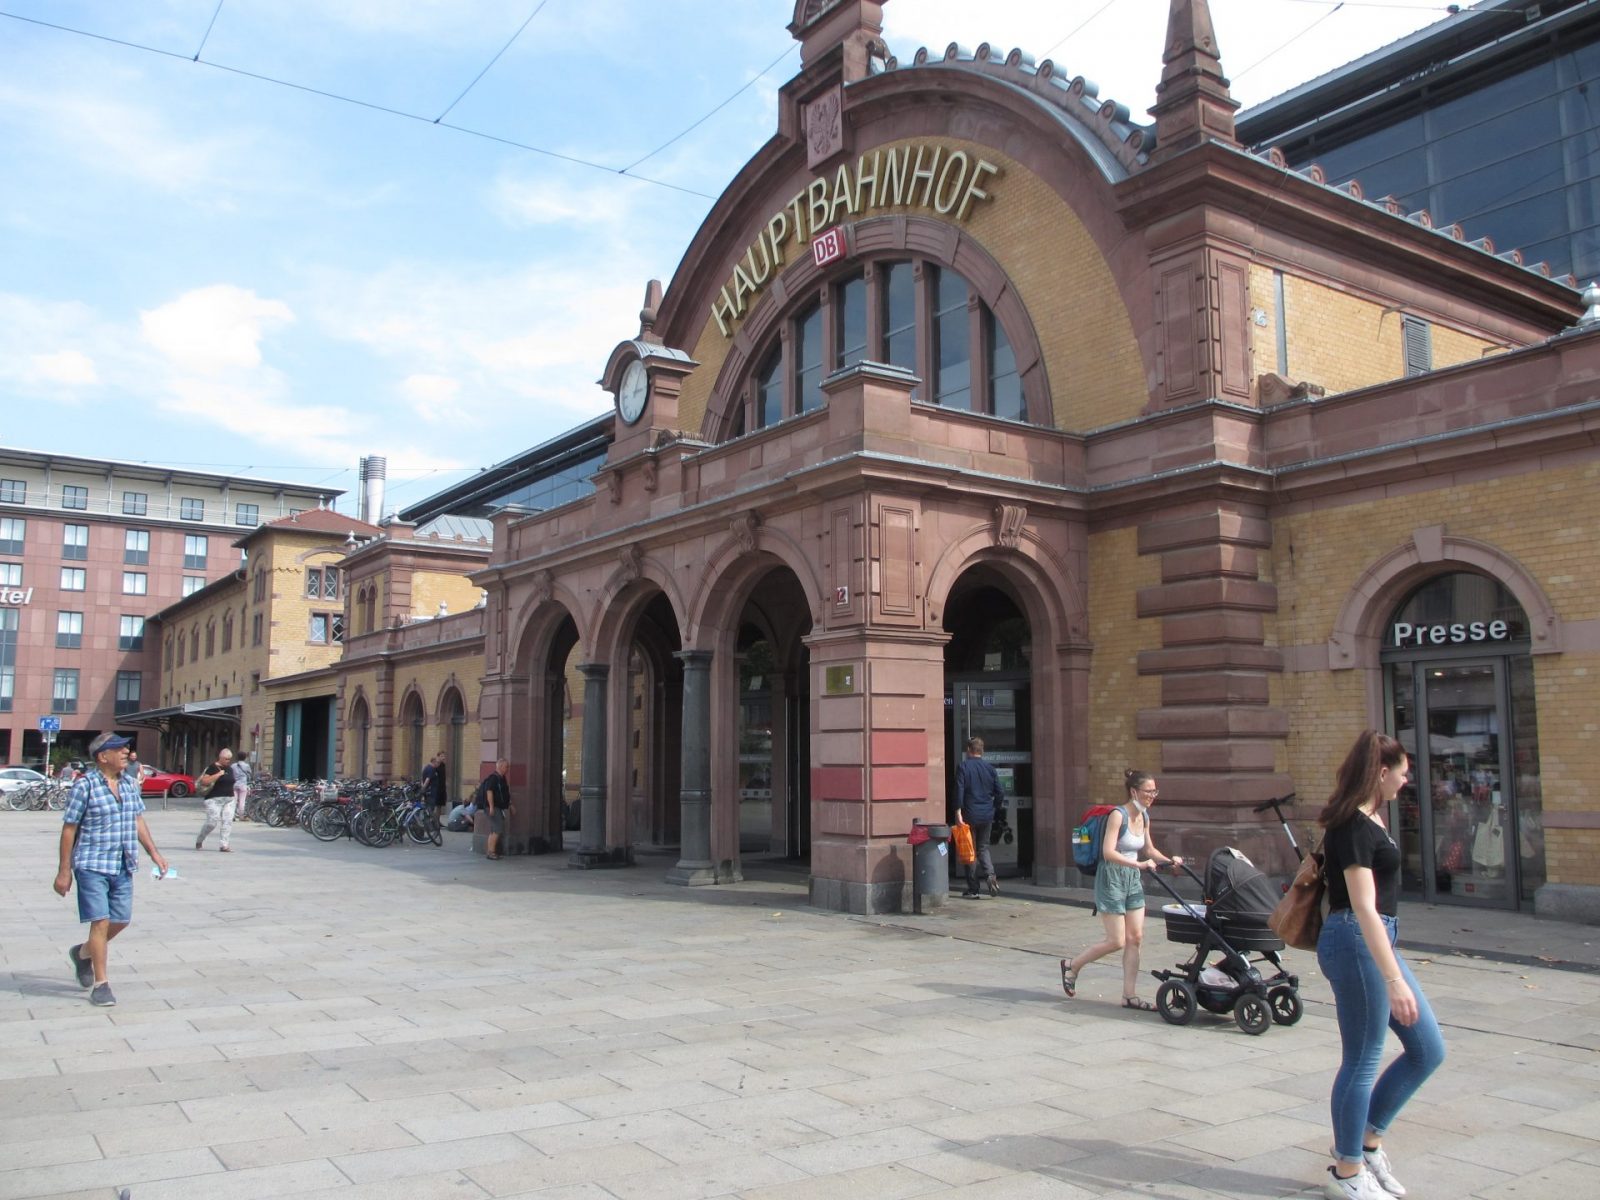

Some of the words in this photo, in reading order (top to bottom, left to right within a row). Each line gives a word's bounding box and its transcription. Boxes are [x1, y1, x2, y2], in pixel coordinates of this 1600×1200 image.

[711, 145, 998, 337] HAUPTBAHNHOF
[815, 235, 836, 261] DB
[1394, 620, 1507, 646] Presse
